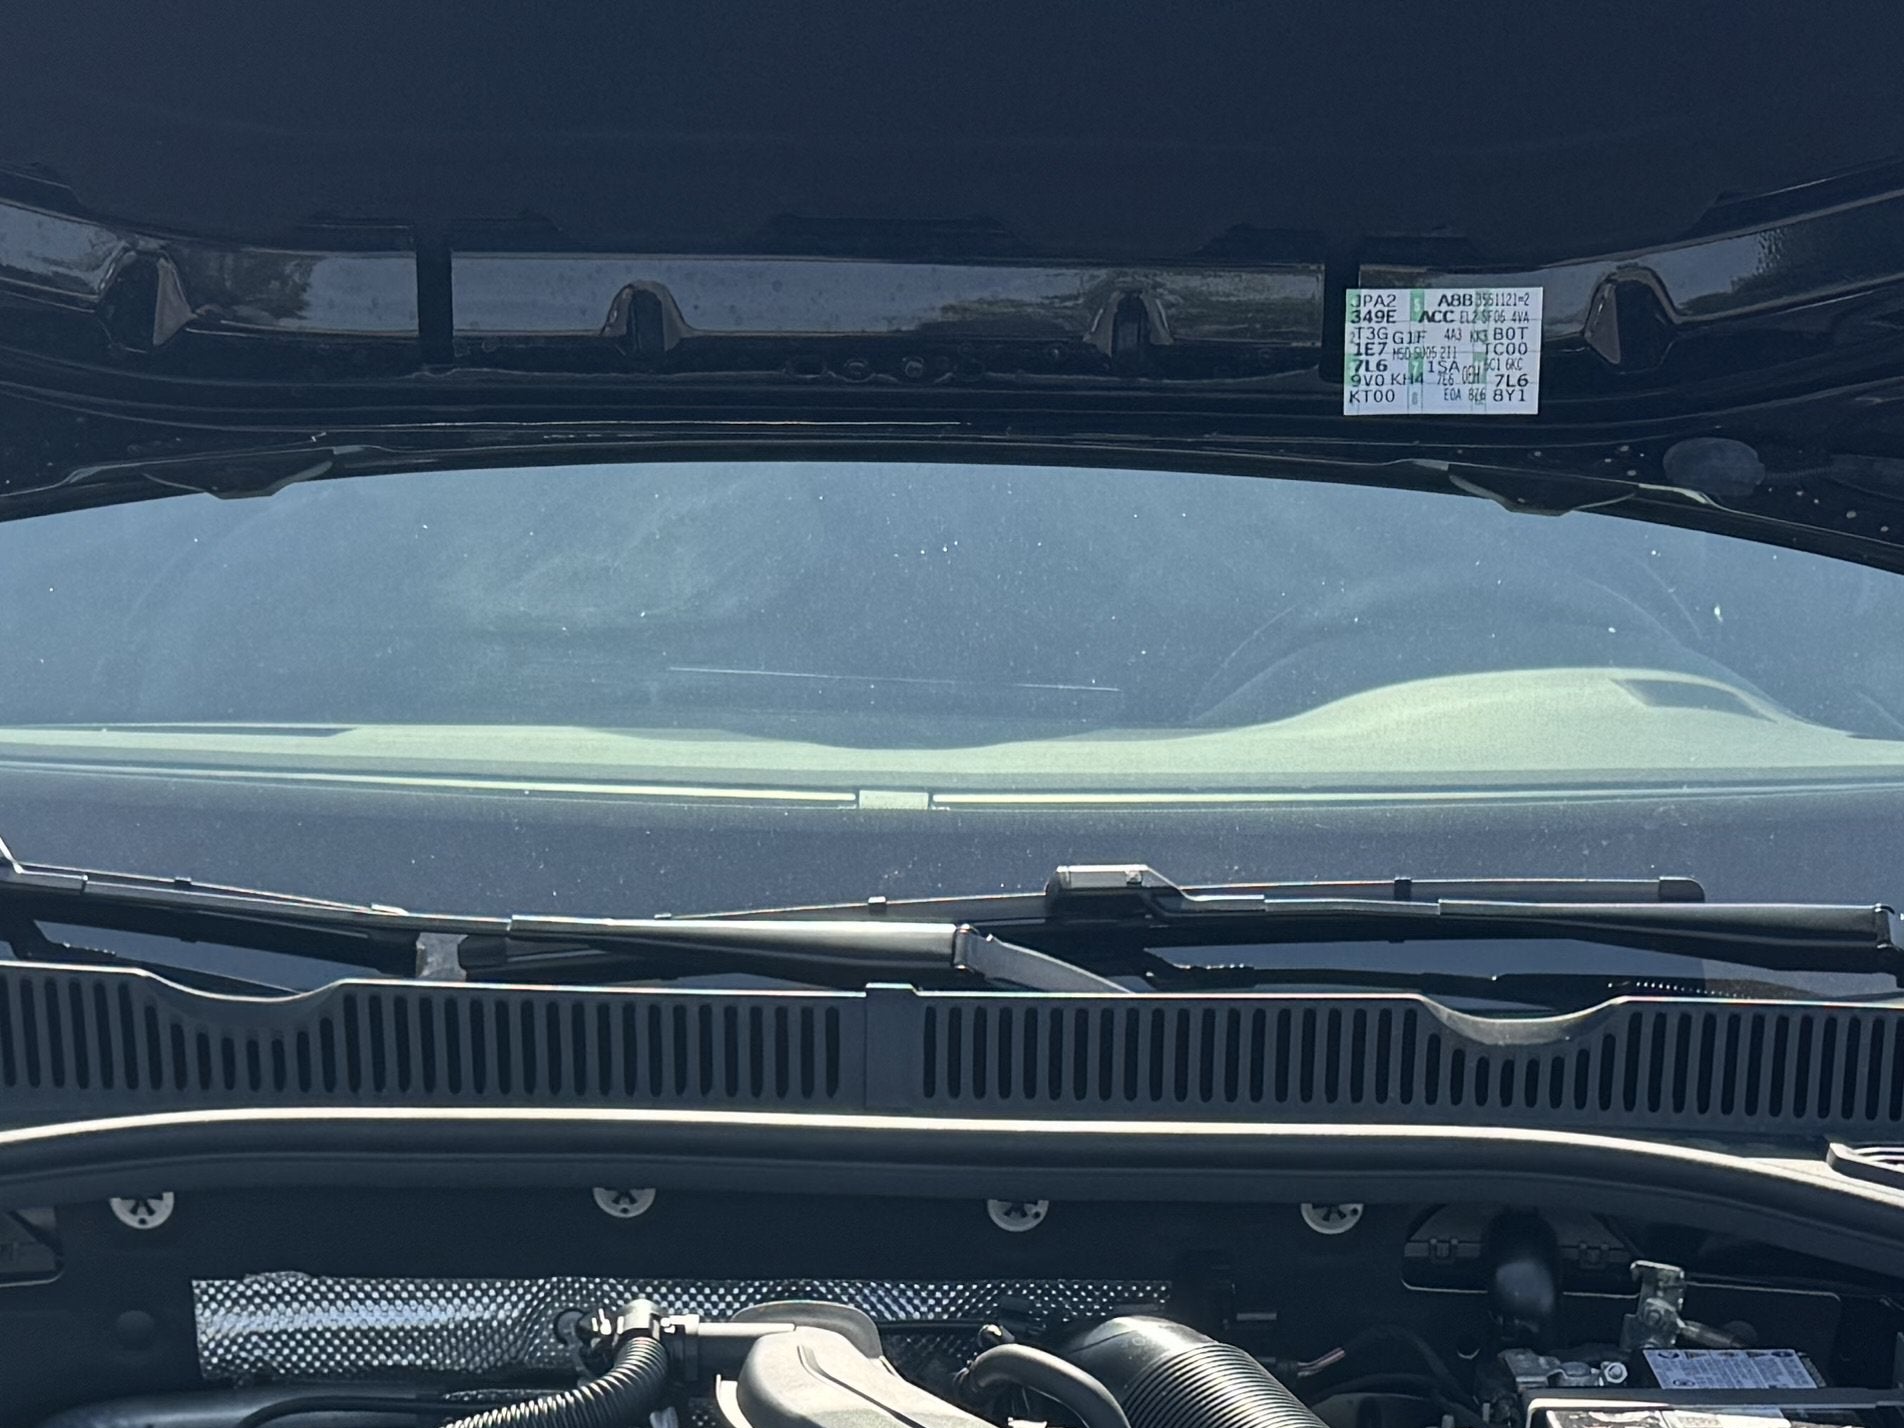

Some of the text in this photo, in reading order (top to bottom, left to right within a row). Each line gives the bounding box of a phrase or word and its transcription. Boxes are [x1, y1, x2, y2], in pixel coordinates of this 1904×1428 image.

[1350, 309, 1397, 324] 349E
[1354, 326, 1388, 340] T3G
[1353, 342, 1387, 356] 1E7
[1354, 359, 1388, 373] 7L6
[1495, 373, 1529, 387] 7L6
[1493, 388, 1526, 402] 8Y1
